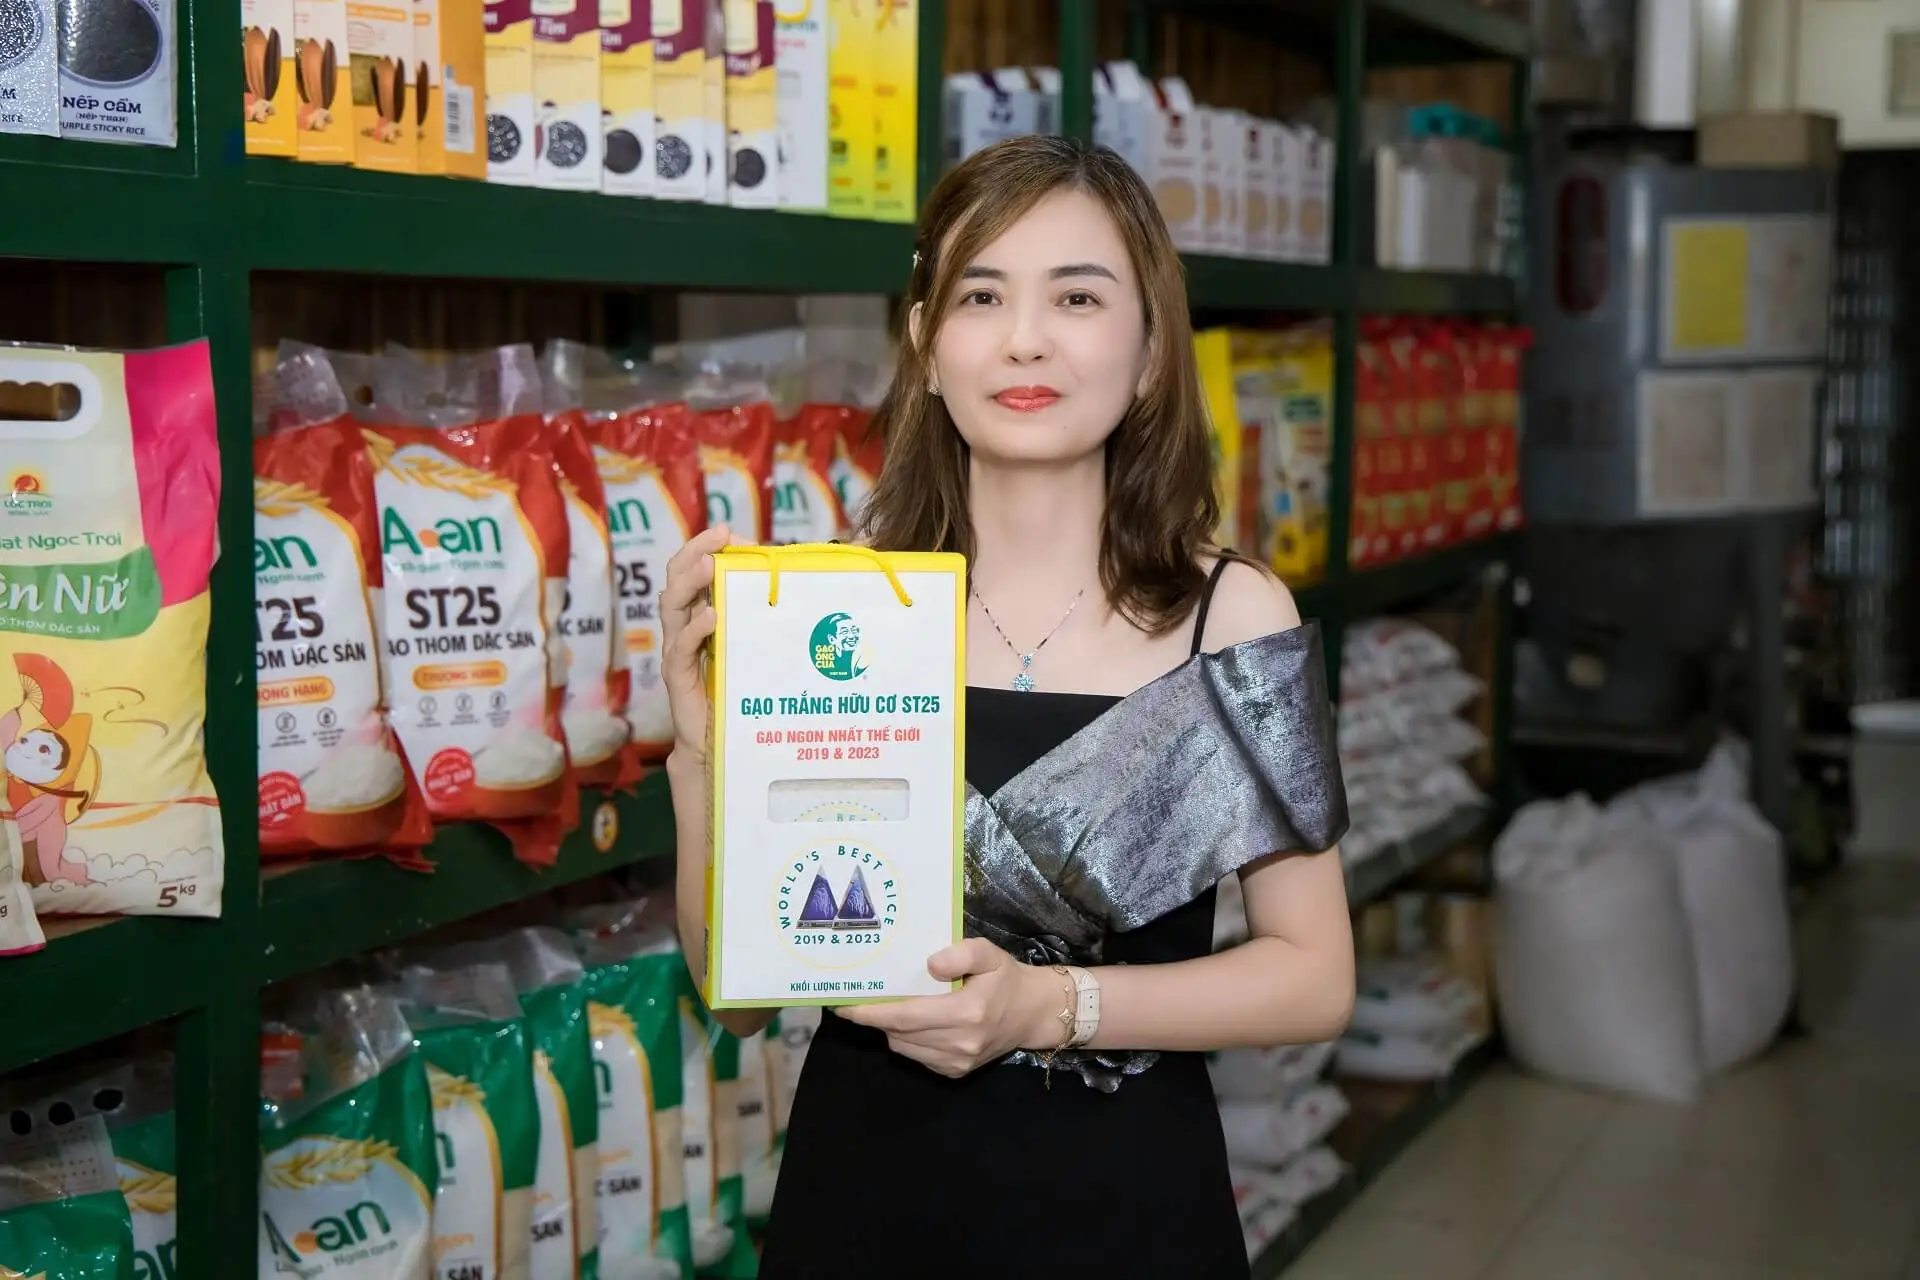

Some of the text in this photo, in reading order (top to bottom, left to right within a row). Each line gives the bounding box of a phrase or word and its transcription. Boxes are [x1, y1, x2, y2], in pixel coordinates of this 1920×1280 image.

[61, 121, 146, 136] URPLE STICKY RICE
[615, 562, 652, 597] 25
[54, 572, 130, 614] Nữ
[406, 585, 502, 629] ST25
[741, 690, 940, 719] GẠO TRẮNG HỮU CƠ ST25
[756, 725, 920, 746] GẠO NGON NHẤT THẾ GIỚI
[796, 746, 880, 761] 2019 & 2023
[778, 845, 897, 929] WORLD'S BEST RICE
[794, 933, 880, 945] 2019 & 2023
[790, 980, 810, 991] KHỐI
[867, 980, 884, 990] 2KG
